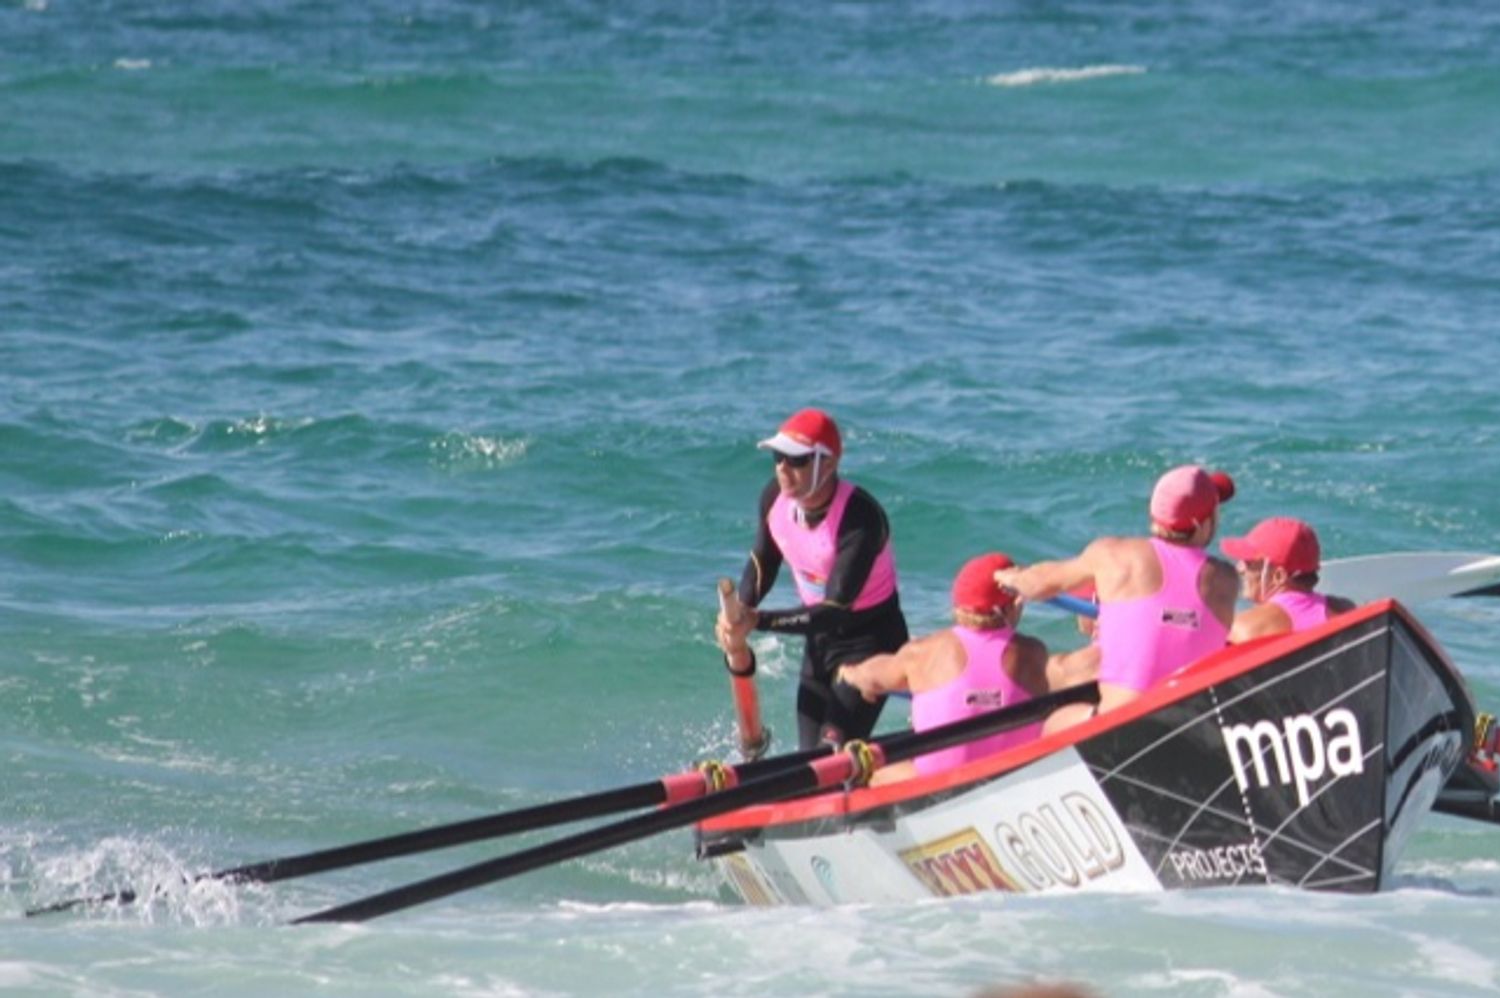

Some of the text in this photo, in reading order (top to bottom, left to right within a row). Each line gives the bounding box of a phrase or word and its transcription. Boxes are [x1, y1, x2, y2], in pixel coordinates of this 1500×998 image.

[1221, 707, 1364, 807] mpa
[995, 792, 1126, 889] GOLD
[1169, 842, 1267, 879] PROJECTS
